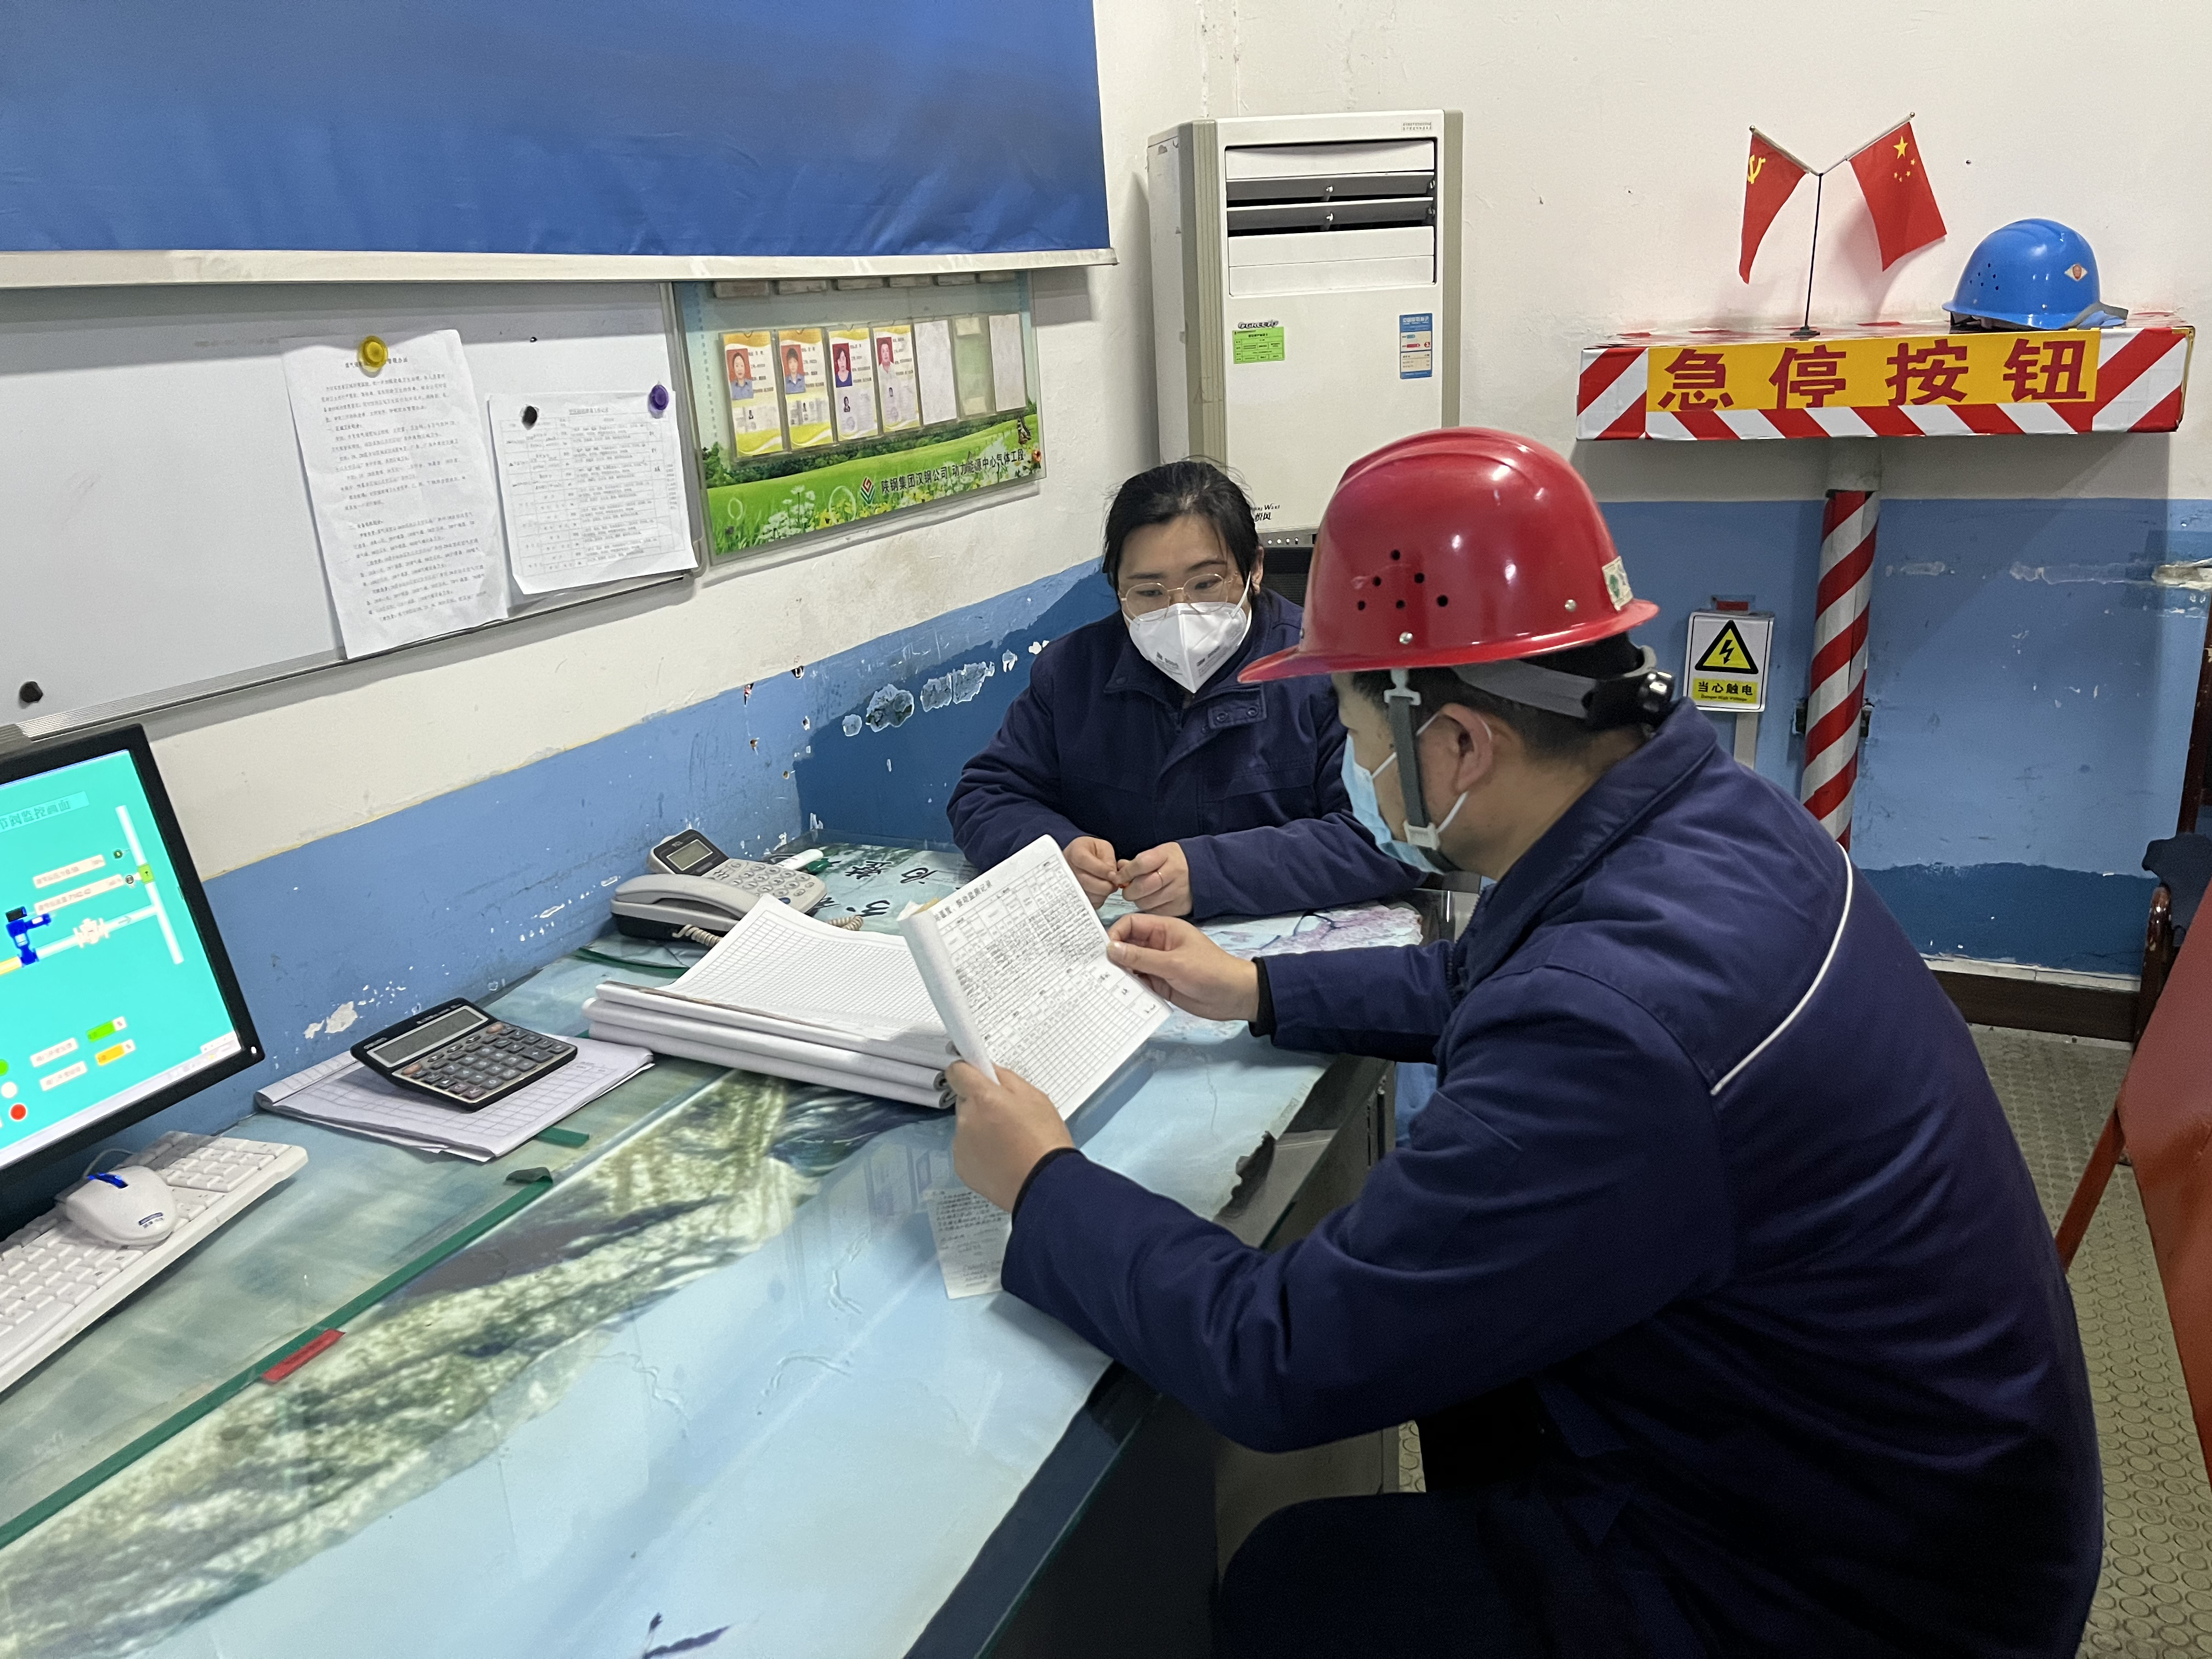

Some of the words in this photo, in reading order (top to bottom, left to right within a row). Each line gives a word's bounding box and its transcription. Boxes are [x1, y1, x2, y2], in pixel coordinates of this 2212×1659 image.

[1657, 338, 2087, 411] 急停按钮
[881, 466, 948, 494] 陕钢集团汉钢公司
[952, 448, 1024, 477] 动力能源中心气体工段
[1698, 681, 1753, 696] 当心触电
